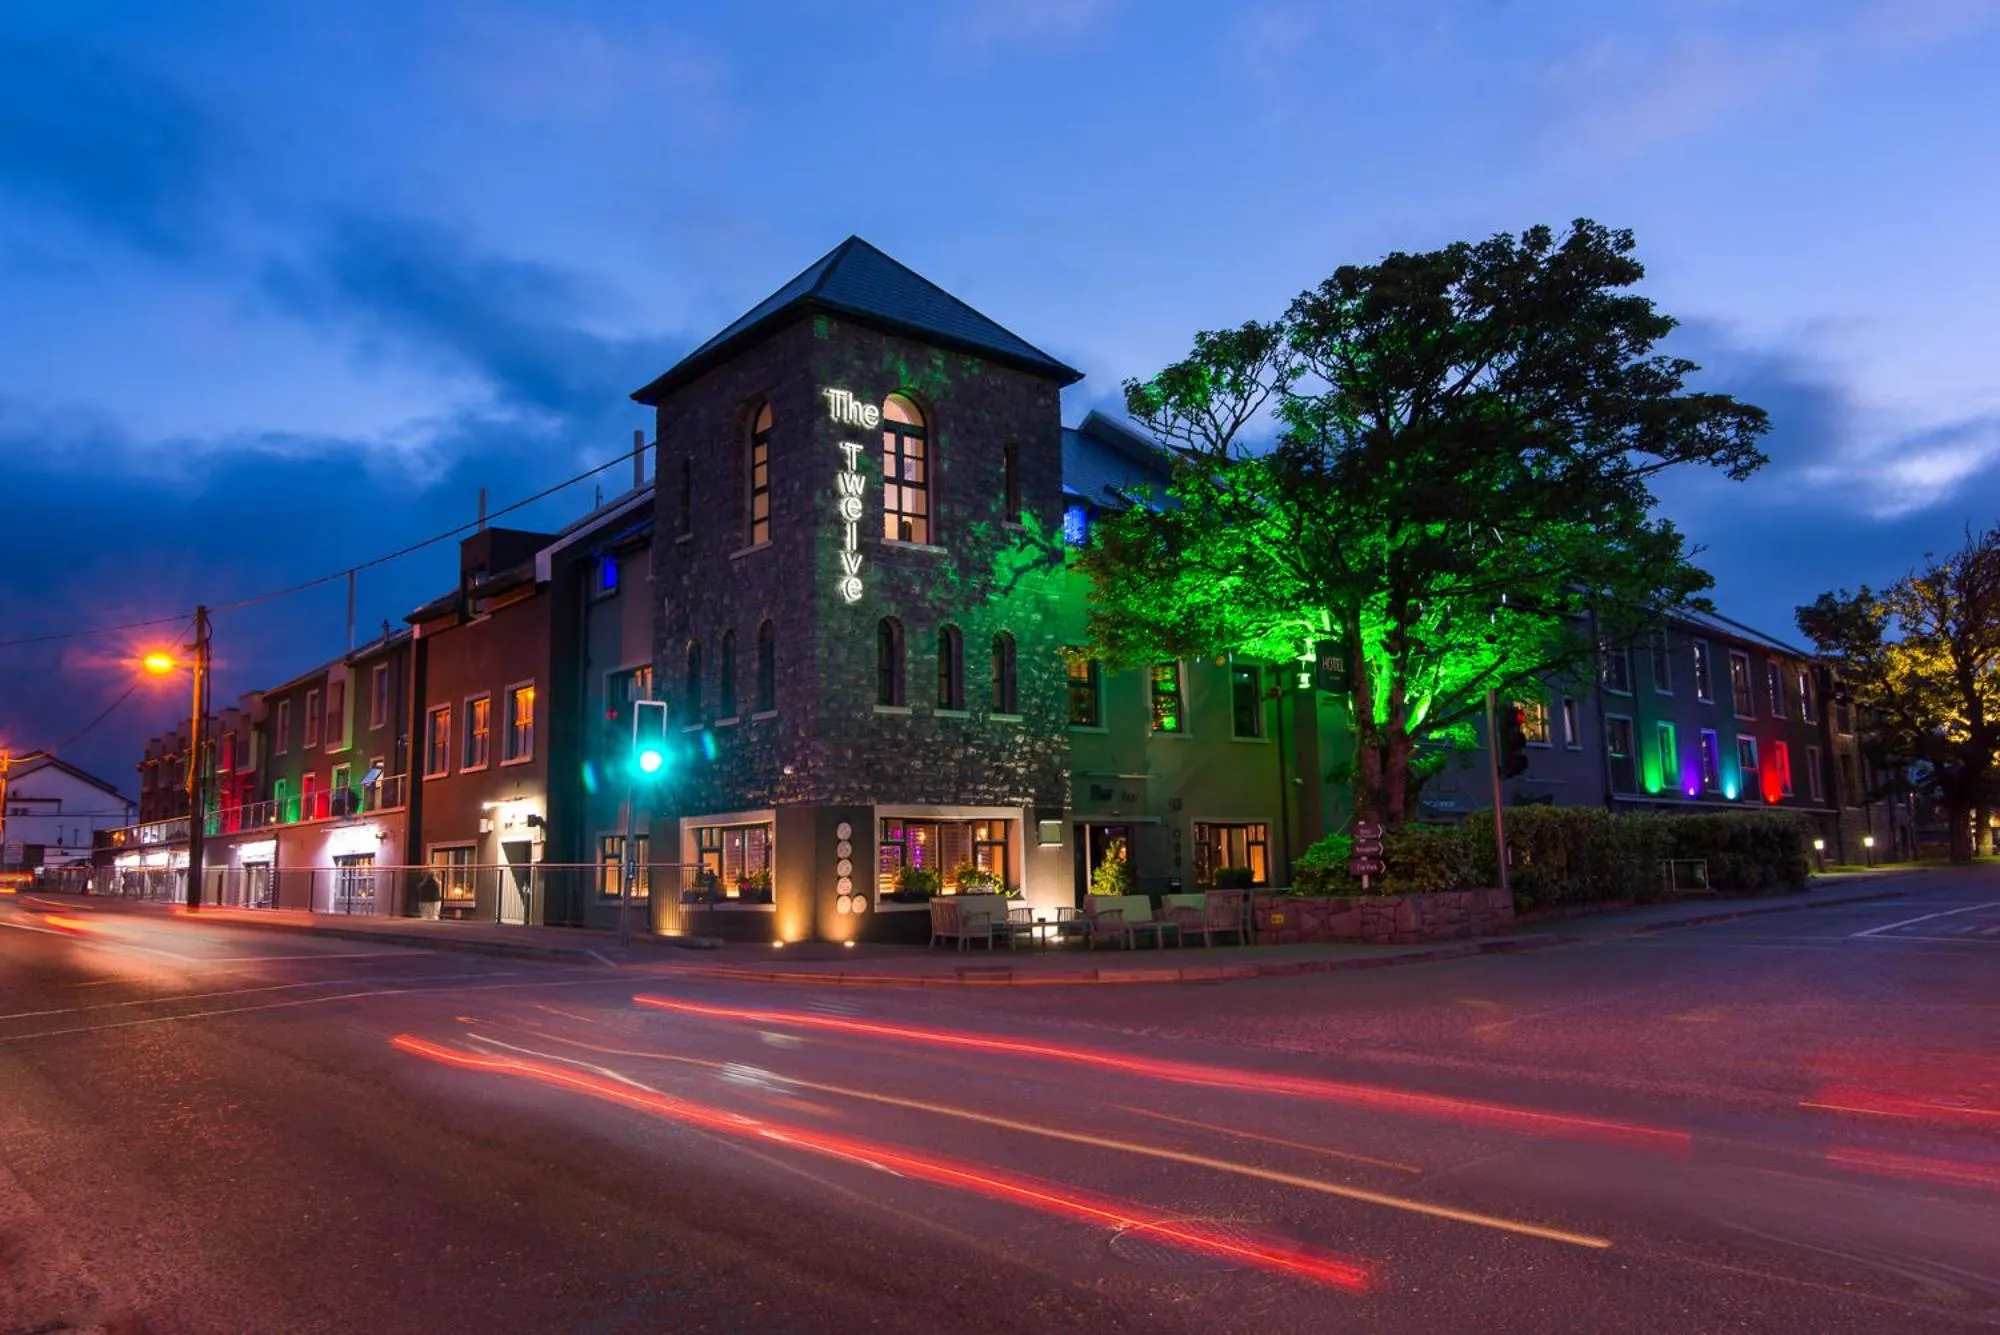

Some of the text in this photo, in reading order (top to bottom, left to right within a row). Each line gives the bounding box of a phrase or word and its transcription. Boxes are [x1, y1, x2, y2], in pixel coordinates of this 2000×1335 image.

[825, 388, 880, 429] The
[838, 441, 867, 604] Twelve
[1322, 656, 1346, 673] HOTEL
